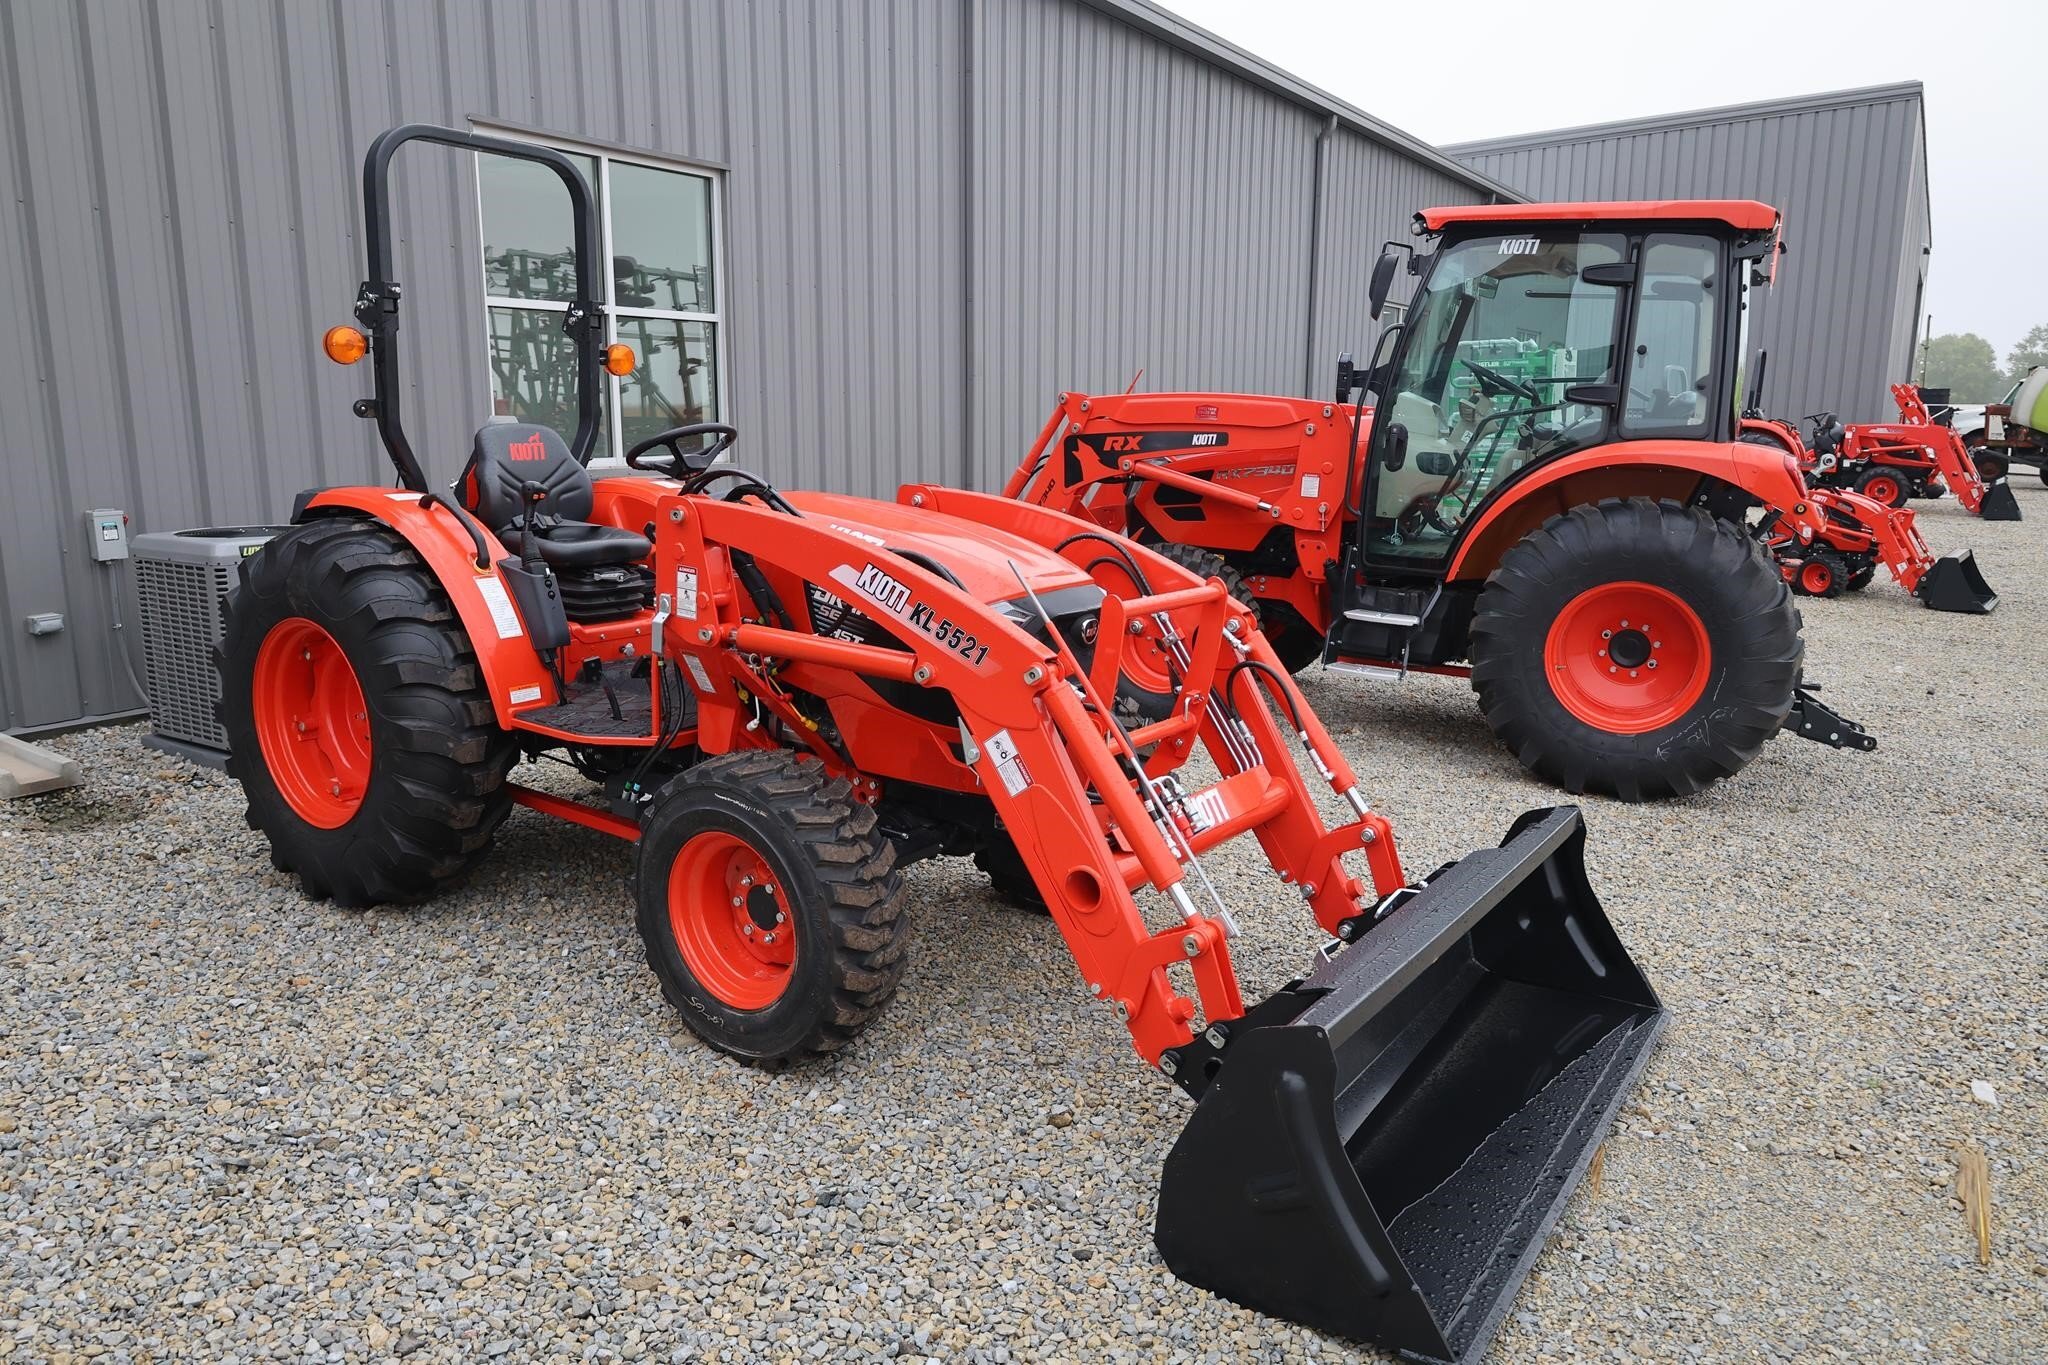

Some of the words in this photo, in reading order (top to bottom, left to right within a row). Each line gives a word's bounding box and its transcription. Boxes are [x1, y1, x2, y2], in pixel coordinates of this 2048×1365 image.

[1497, 238, 1541, 255] KIOTI
[1103, 435, 1143, 451] RX
[1191, 433, 1217, 446] KIOTI
[509, 442, 545, 461] KIOTI
[856, 561, 913, 614] KIOTI
